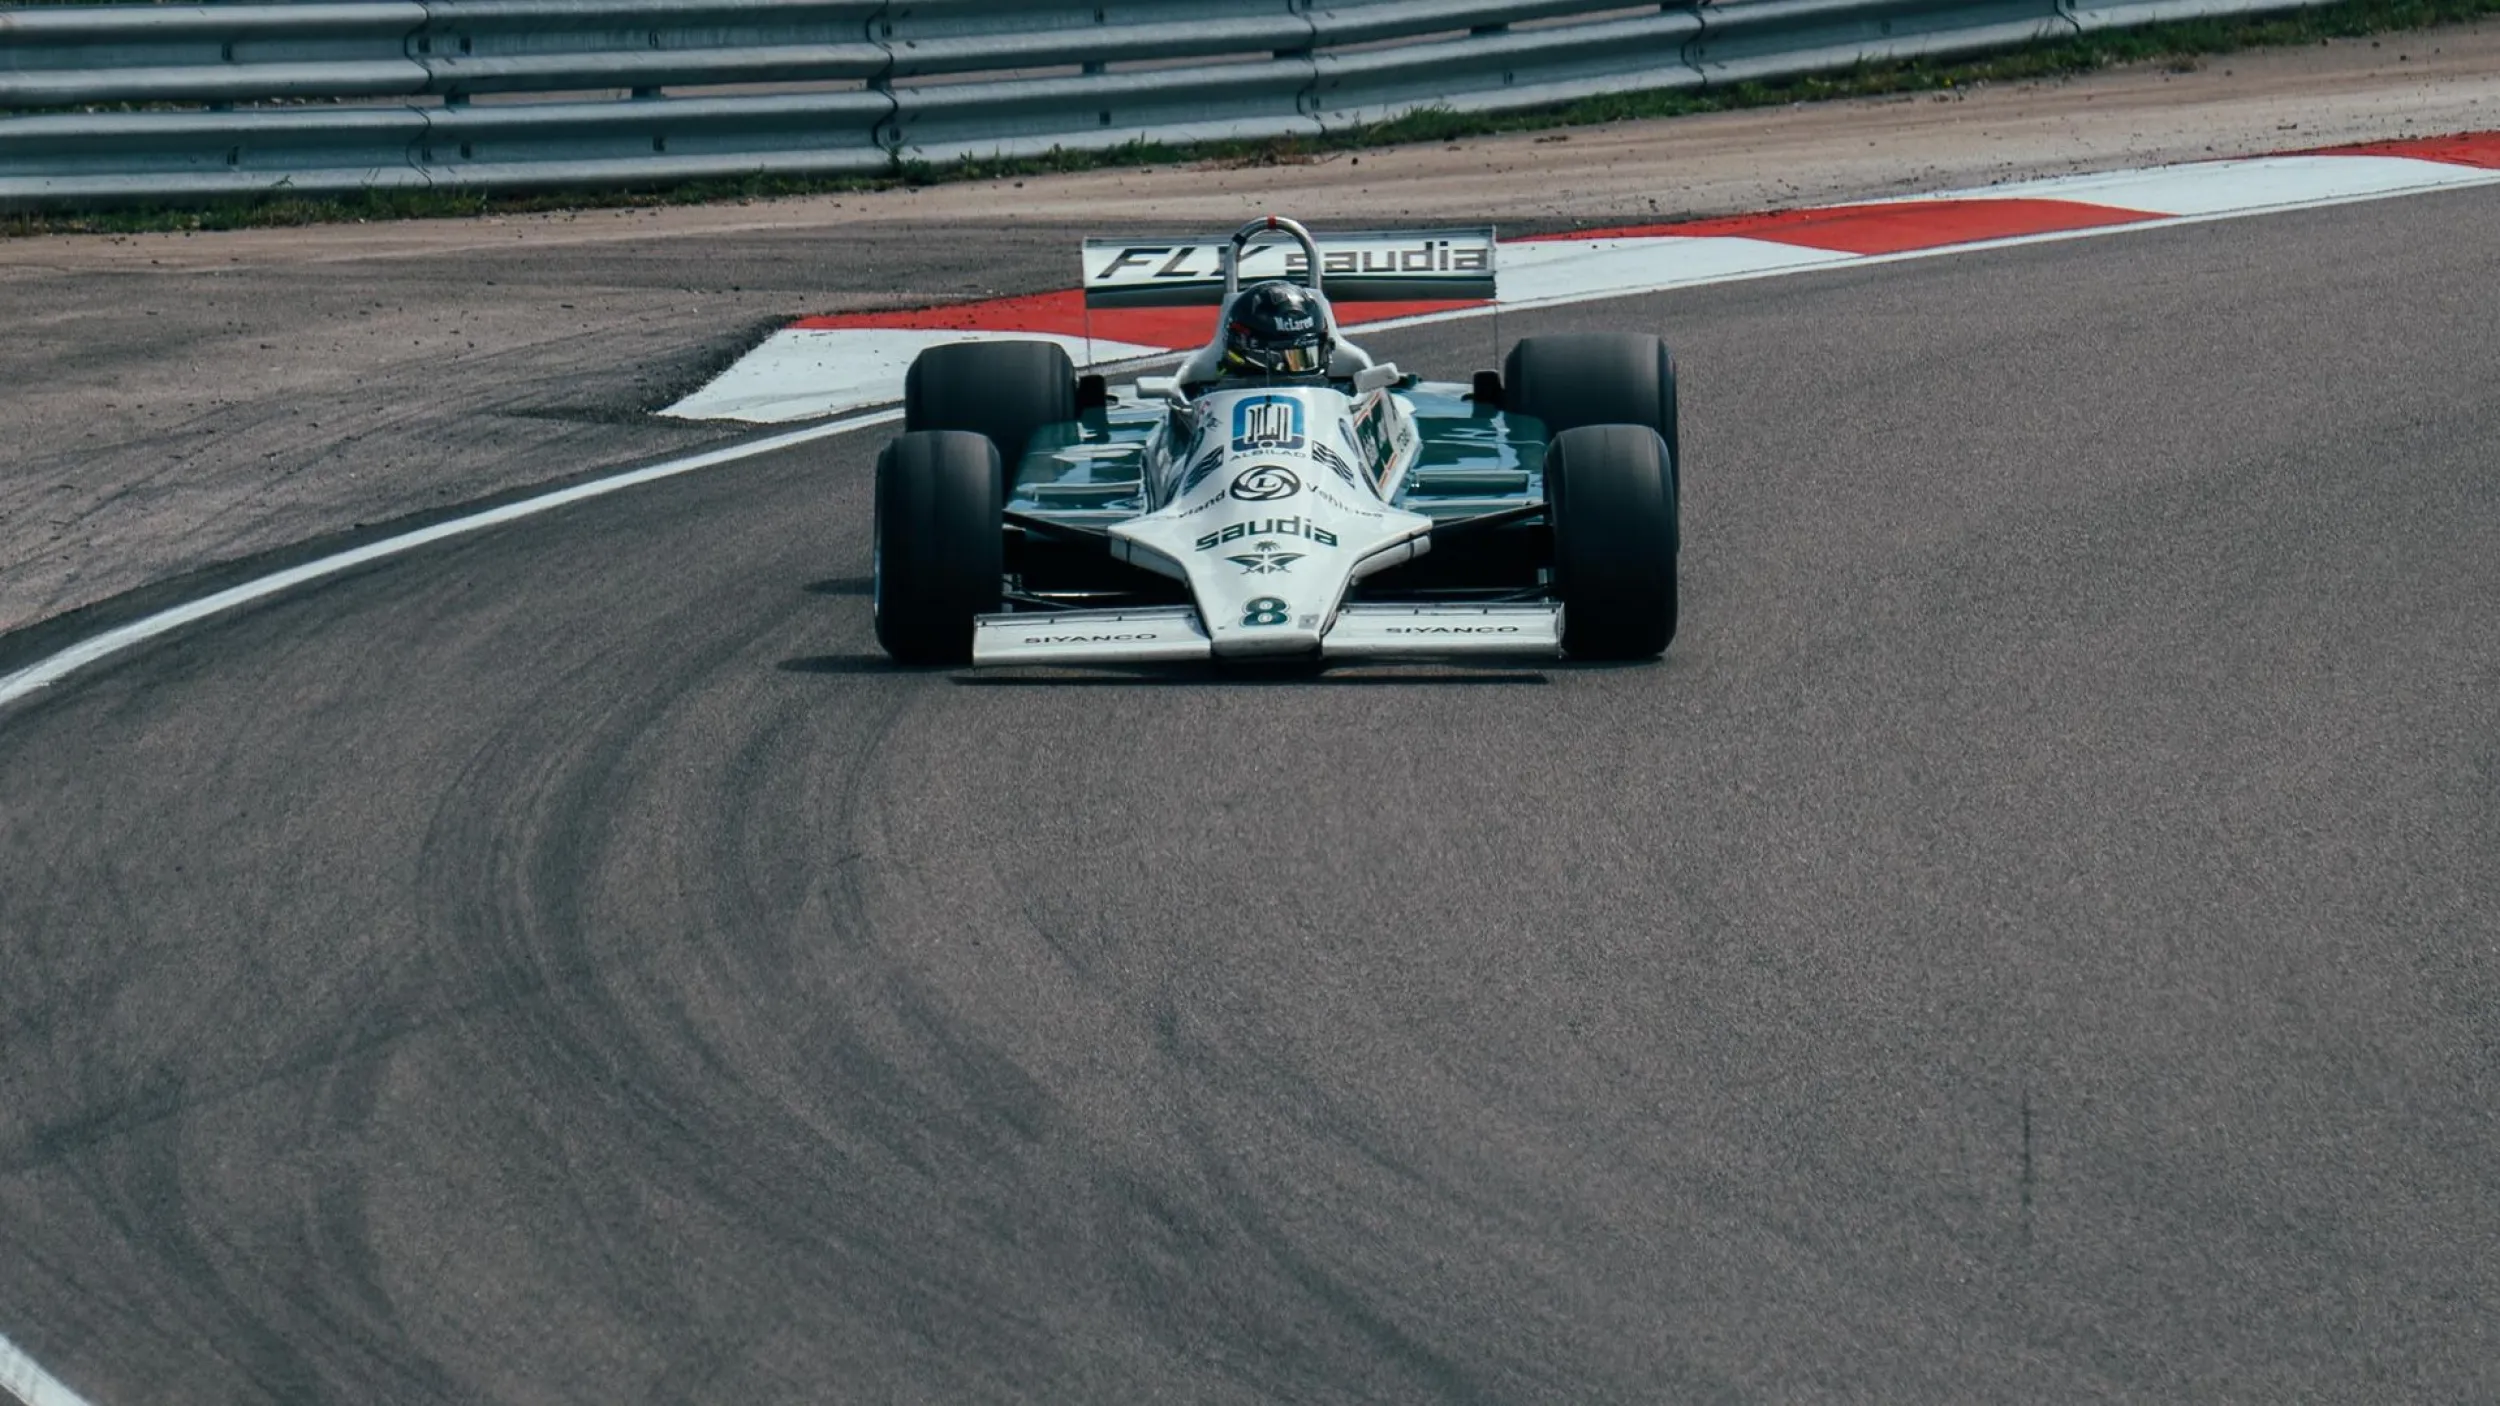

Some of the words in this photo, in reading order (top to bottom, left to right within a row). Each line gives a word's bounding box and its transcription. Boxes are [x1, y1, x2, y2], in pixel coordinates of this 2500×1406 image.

[1096, 245, 1273, 279] FLY
[1285, 241, 1488, 275] saudia
[1229, 449, 1307, 462] ALBILAD
[1195, 515, 1339, 551] saudia
[1240, 595, 1291, 627] 8
[1025, 633, 1157, 643] SIYANCO
[1386, 625, 1519, 633] SIYANCO
